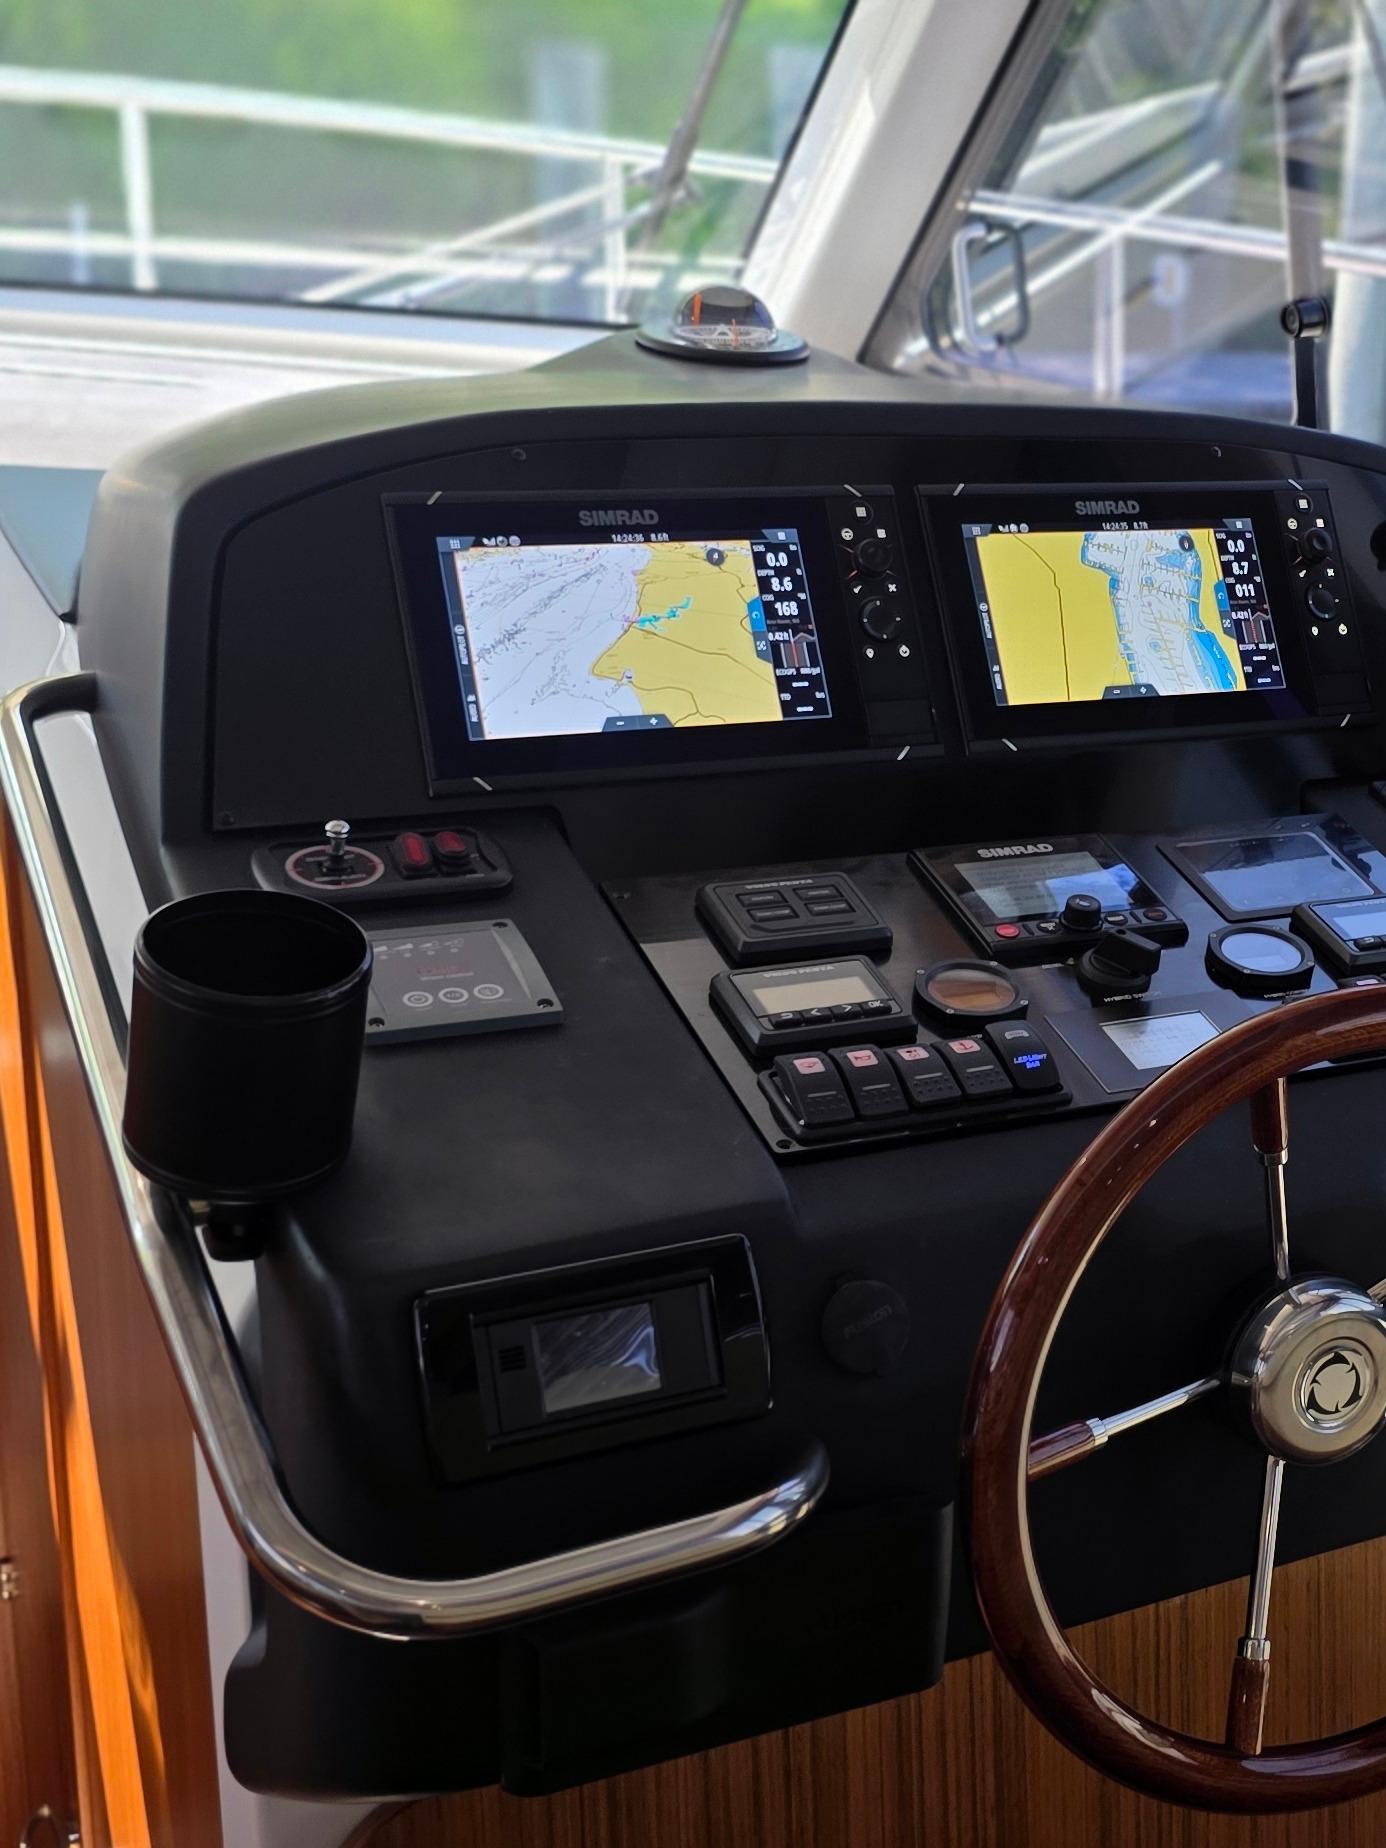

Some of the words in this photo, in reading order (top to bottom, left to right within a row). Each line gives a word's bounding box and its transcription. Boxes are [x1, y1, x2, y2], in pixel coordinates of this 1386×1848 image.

[1075, 501, 1140, 516] SIMRAD
[578, 510, 660, 527] SIMRAD
[1227, 539, 1245, 553] 0.0
[766, 551, 789, 567] 0.0
[1232, 561, 1249, 575] 8.7
[770, 576, 793, 592] 8.6
[1235, 583, 1256, 598] 011
[774, 601, 799, 616] 168
[977, 843, 1054, 859] SIMRAD
[868, 1000, 884, 1008] OK
